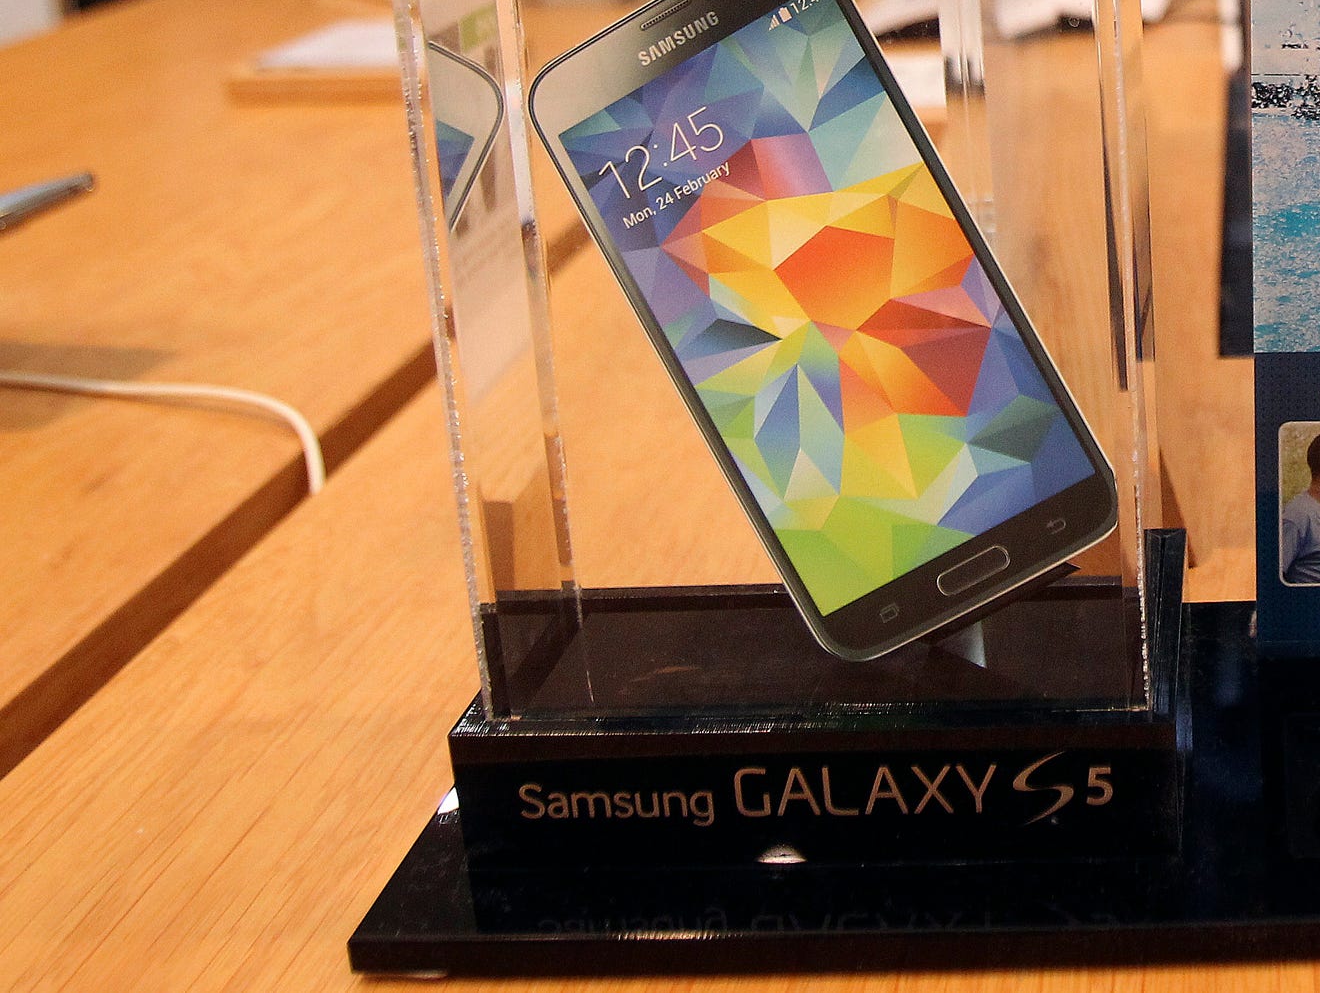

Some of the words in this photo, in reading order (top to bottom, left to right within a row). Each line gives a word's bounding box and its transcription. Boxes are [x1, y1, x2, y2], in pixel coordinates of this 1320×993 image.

[637, 10, 720, 67] SAMSUNG
[598, 106, 724, 200] 12:45
[622, 206, 657, 229] Mon,
[655, 192, 675, 210] 24
[673, 161, 731, 200] February
[518, 783, 715, 826] Samsung
[734, 764, 998, 817] GALAXY
